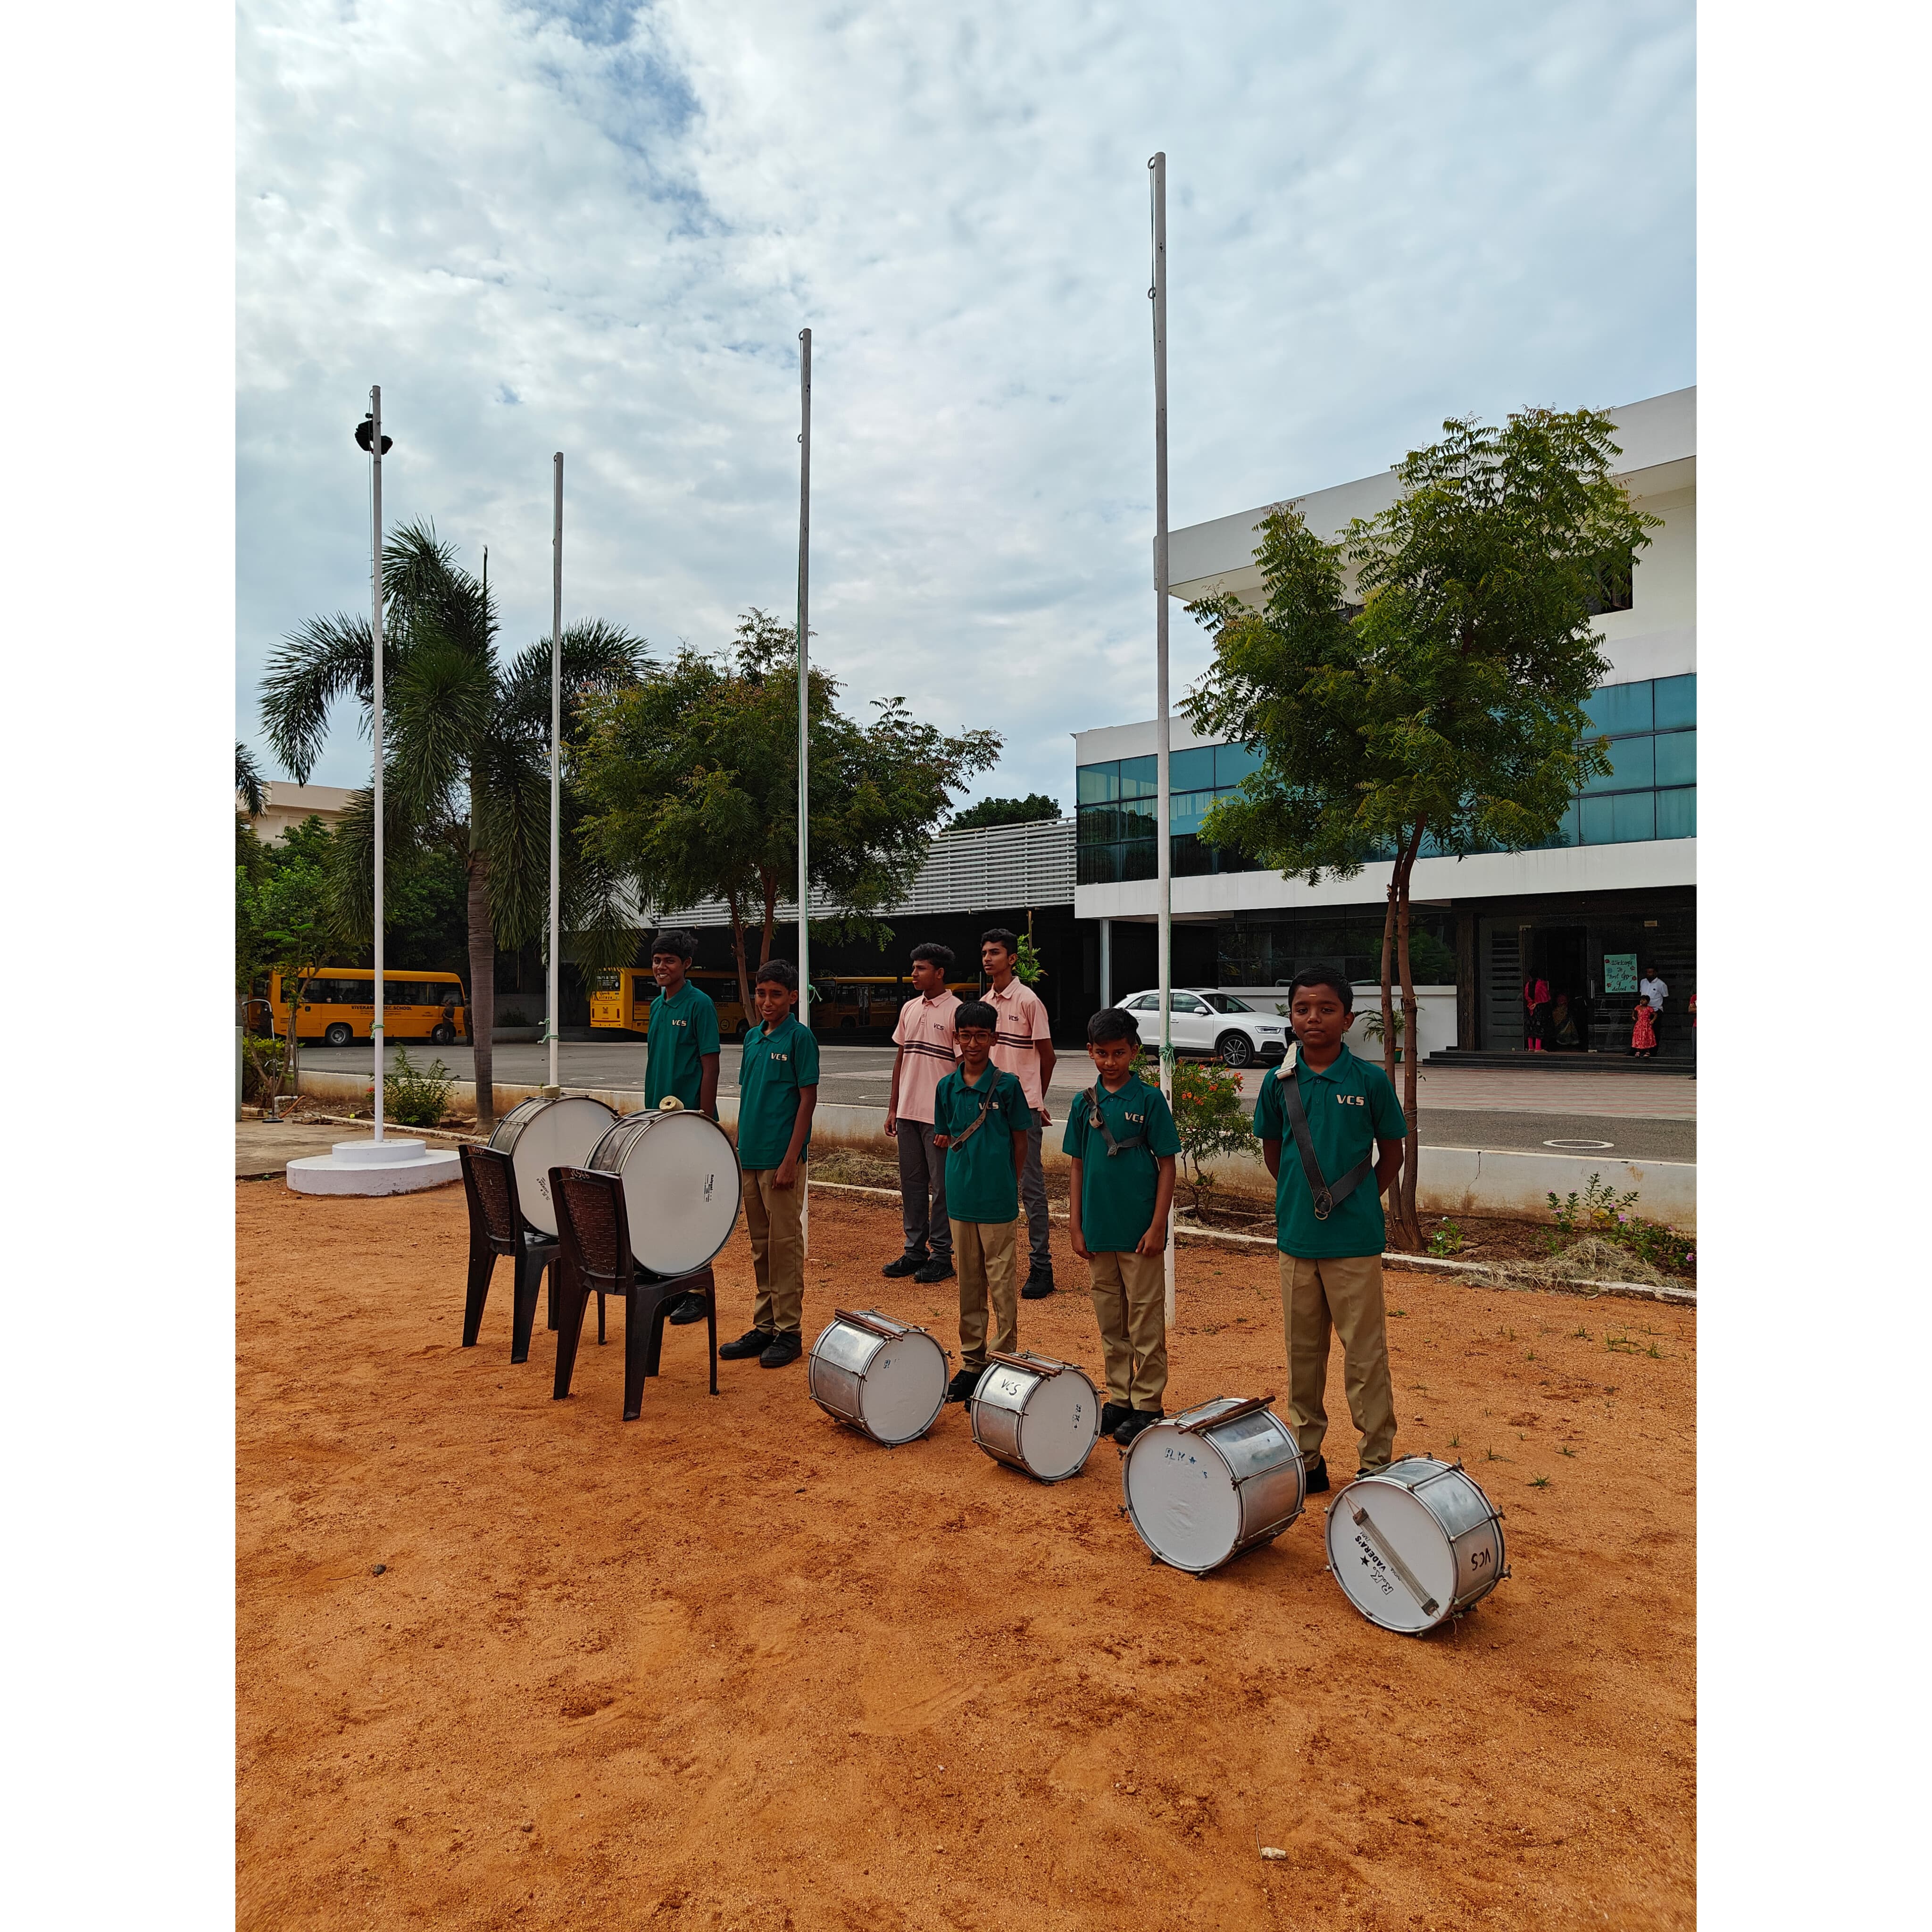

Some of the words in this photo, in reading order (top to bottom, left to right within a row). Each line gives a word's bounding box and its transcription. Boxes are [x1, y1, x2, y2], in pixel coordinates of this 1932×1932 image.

[933, 1023, 944, 1031] VCS
[771, 1052, 788, 1061] VCS
[1336, 1094, 1364, 1106] VCS
[1124, 1112, 1144, 1123] VCS
[1001, 1378, 1021, 1396] VCS
[1355, 1535, 1386, 1573] VADERA'S
[1471, 1547, 1491, 1571] VCS
